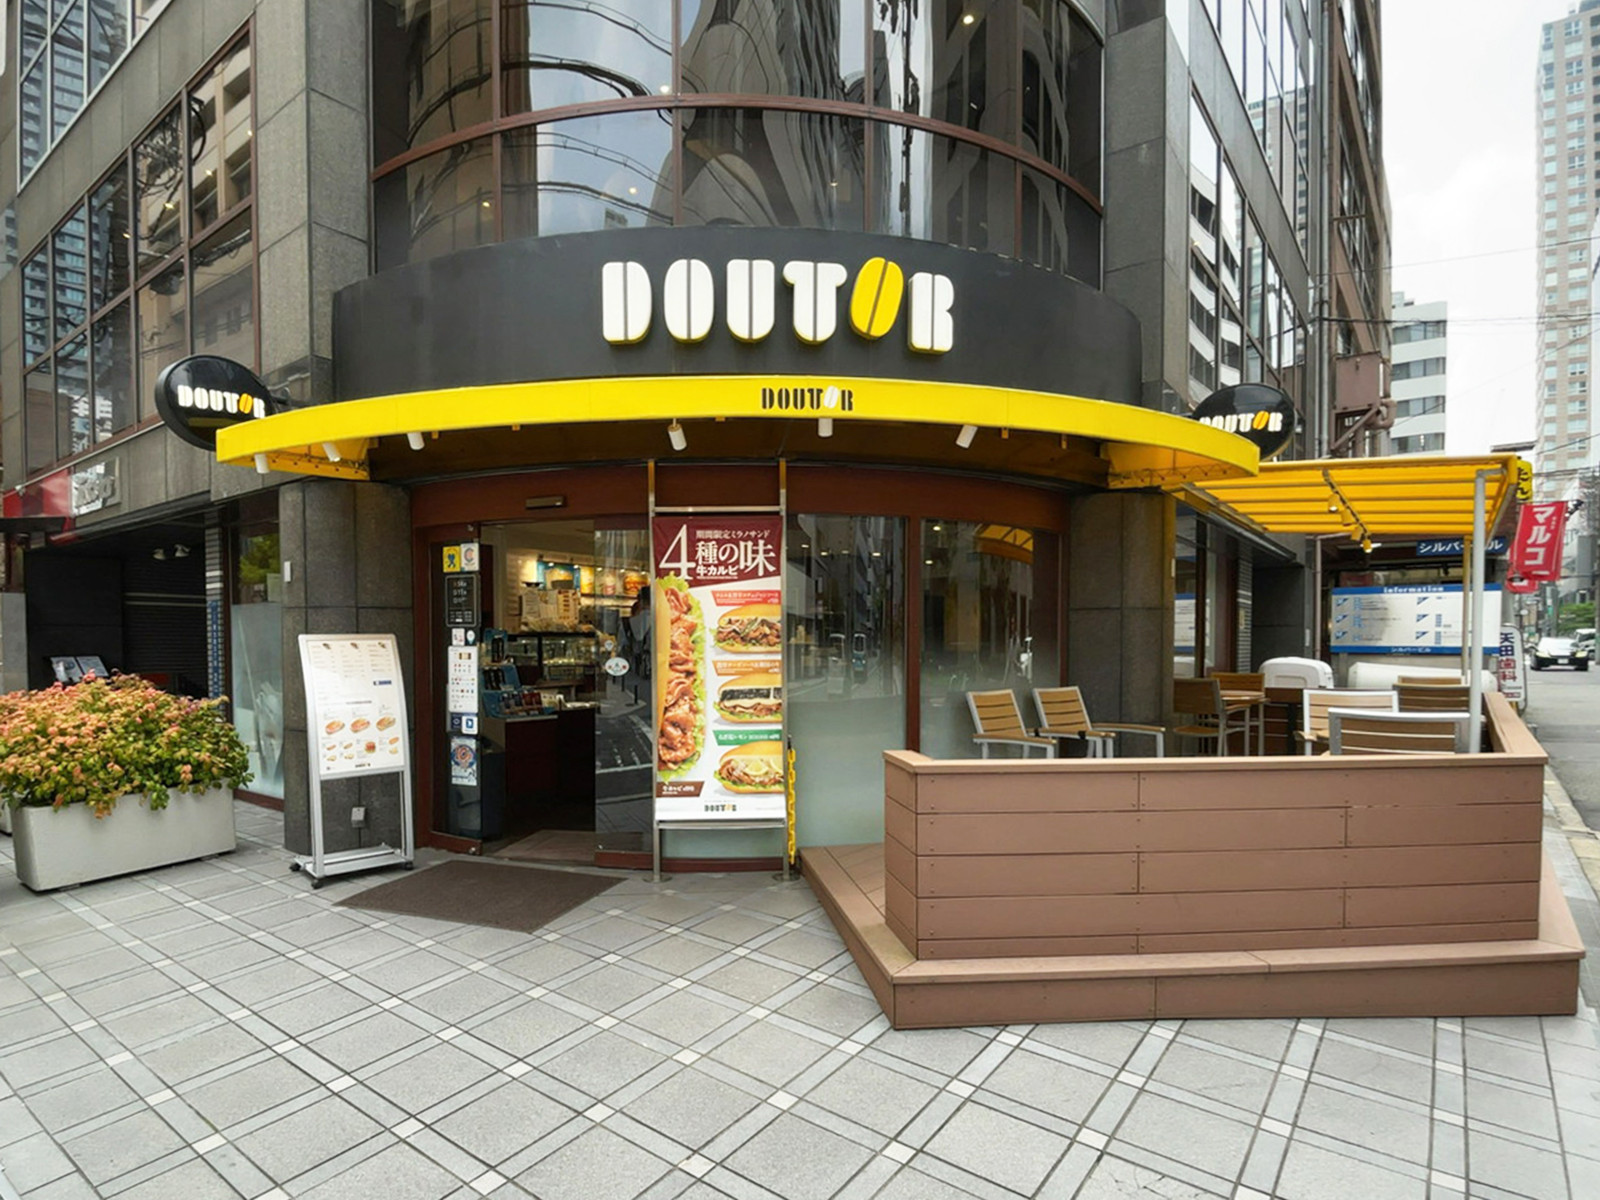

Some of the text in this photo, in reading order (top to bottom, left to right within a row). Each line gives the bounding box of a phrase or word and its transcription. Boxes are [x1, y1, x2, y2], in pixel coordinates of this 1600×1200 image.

[602, 257, 954, 354] DOUTOR
[177, 384, 266, 419] DOUTOR
[761, 385, 853, 411] DOUTOR
[695, 564, 739, 576] 牛カルビ
